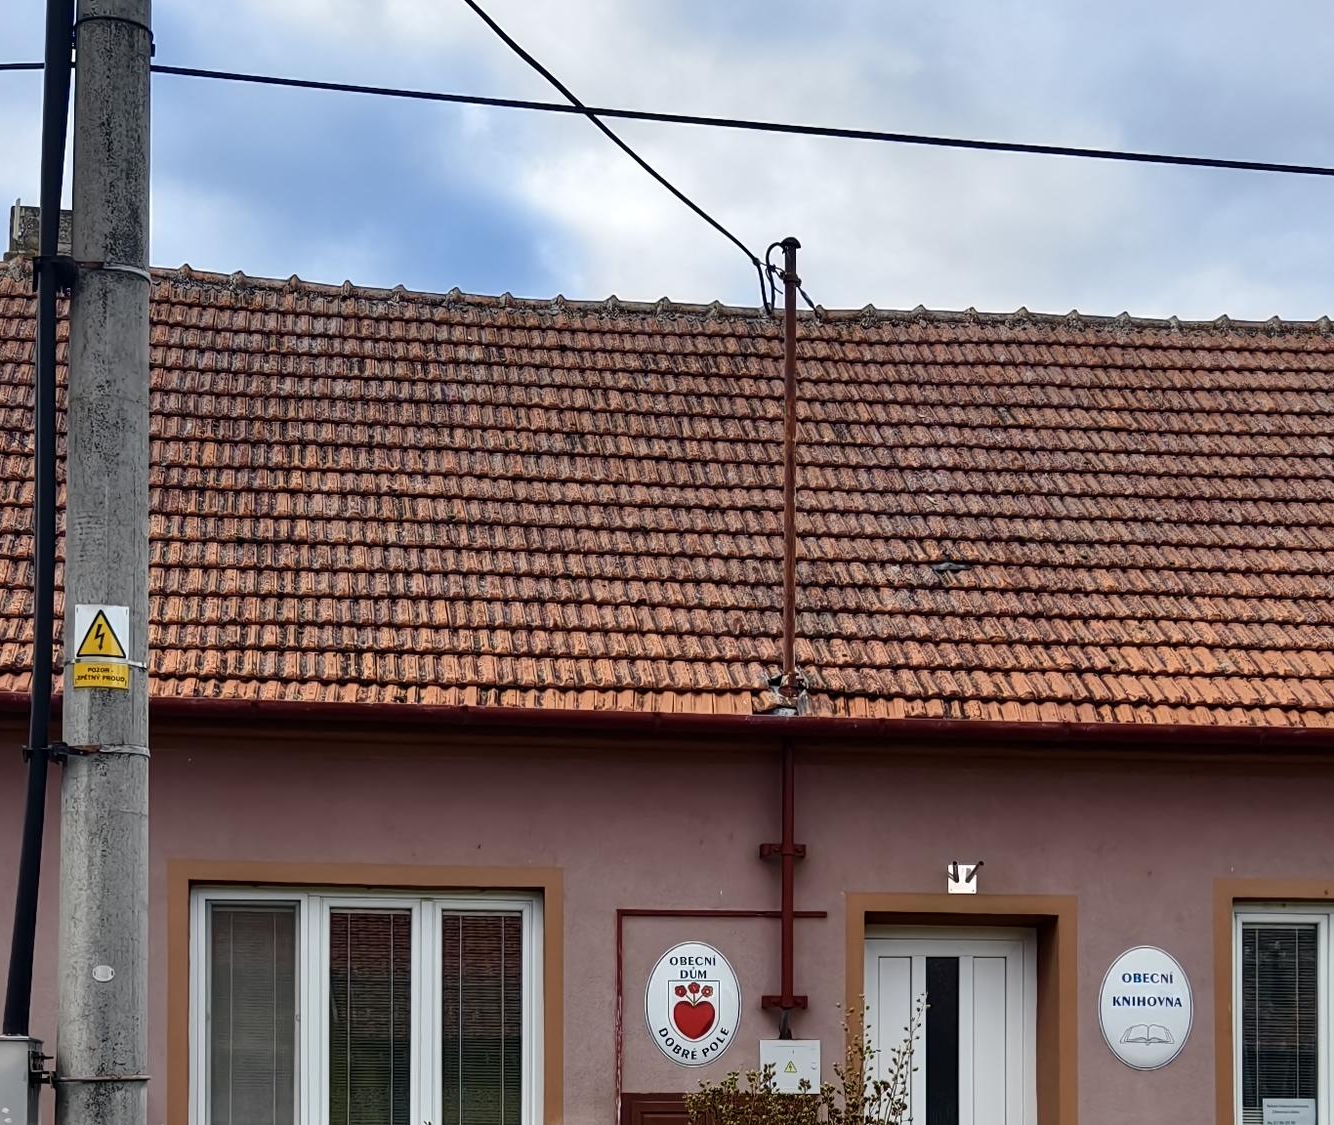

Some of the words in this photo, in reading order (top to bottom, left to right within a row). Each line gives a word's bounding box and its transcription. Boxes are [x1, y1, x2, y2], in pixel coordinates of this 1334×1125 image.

[669, 955, 716, 966] OBECNÍ
[680, 967, 707, 979] DŮM
[1122, 971, 1174, 984] OBECNÍ
[1112, 996, 1182, 1007] KNIHOVNA
[658, 1027, 697, 1060] DOBRÉ
[702, 1027, 729, 1058] POLE
